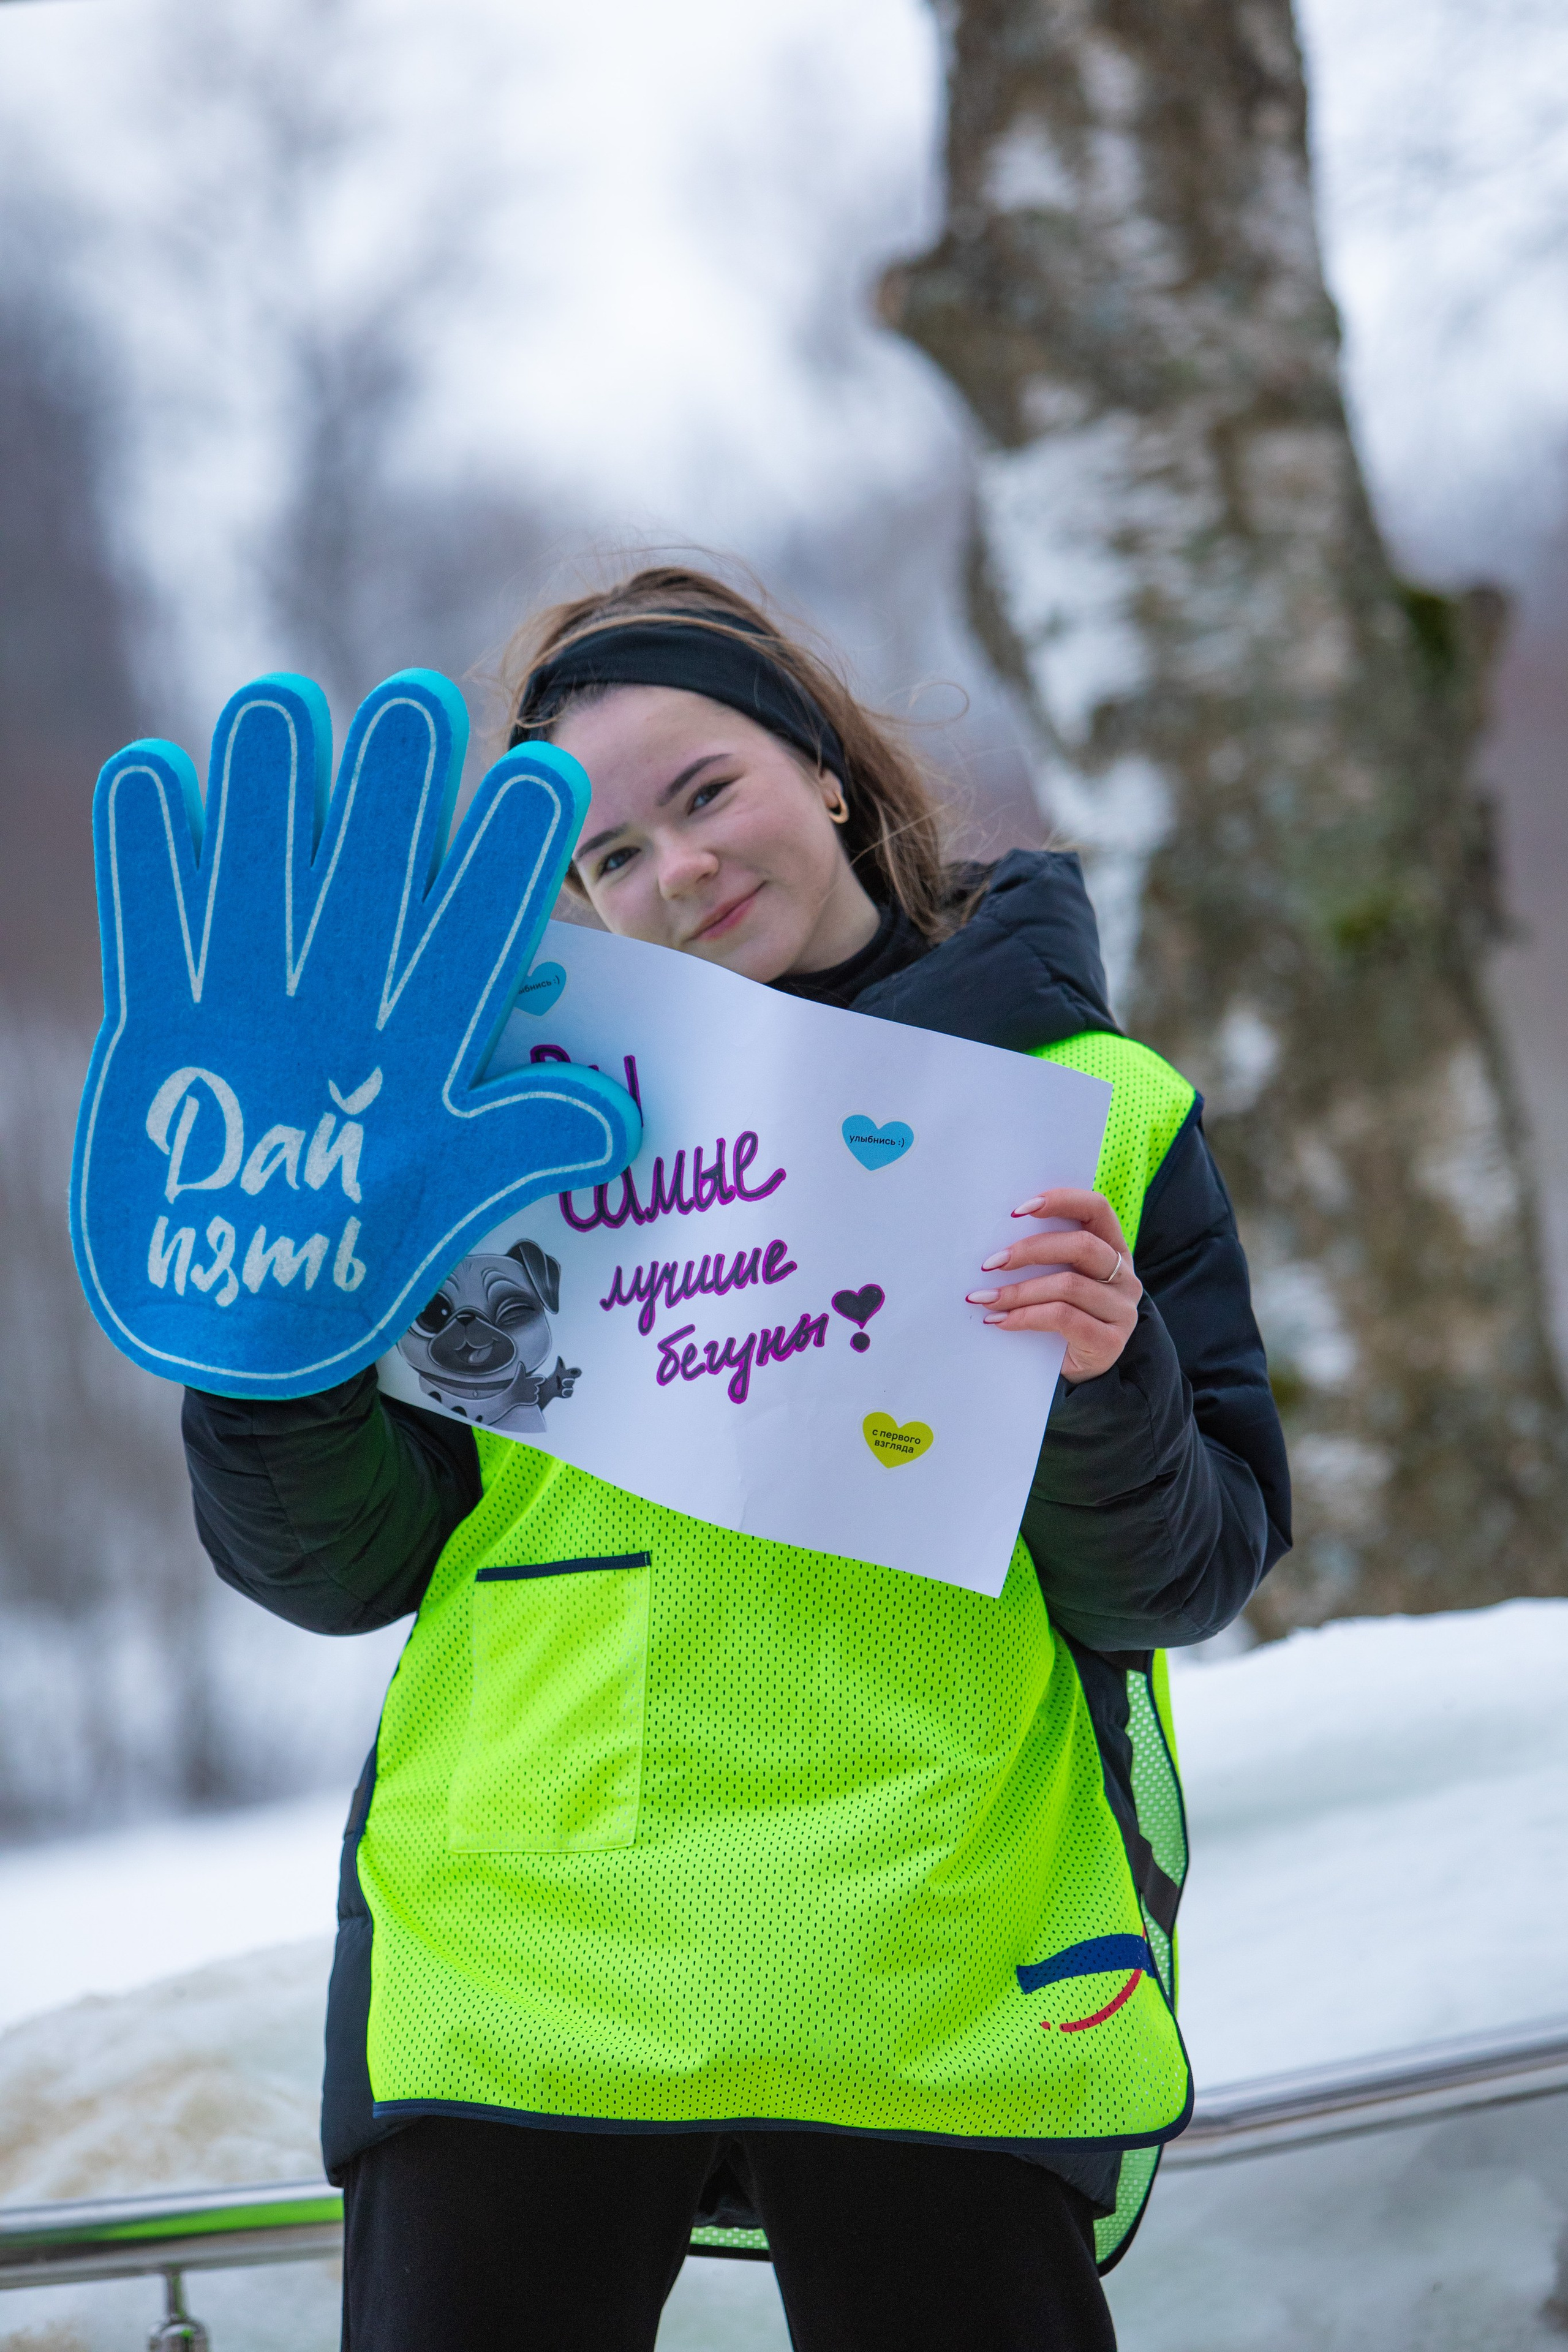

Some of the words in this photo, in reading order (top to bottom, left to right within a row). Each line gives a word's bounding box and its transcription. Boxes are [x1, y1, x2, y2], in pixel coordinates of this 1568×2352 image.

[518, 981, 552, 995] ыбнись
[146, 1066, 383, 1204] Дай
[850, 1135, 895, 1145] улыбнись
[148, 1215, 366, 1307] пять
[599, 1239, 797, 1335] лучшие
[880, 1430, 921, 1444] первого
[874, 1439, 914, 1453] взгляда
